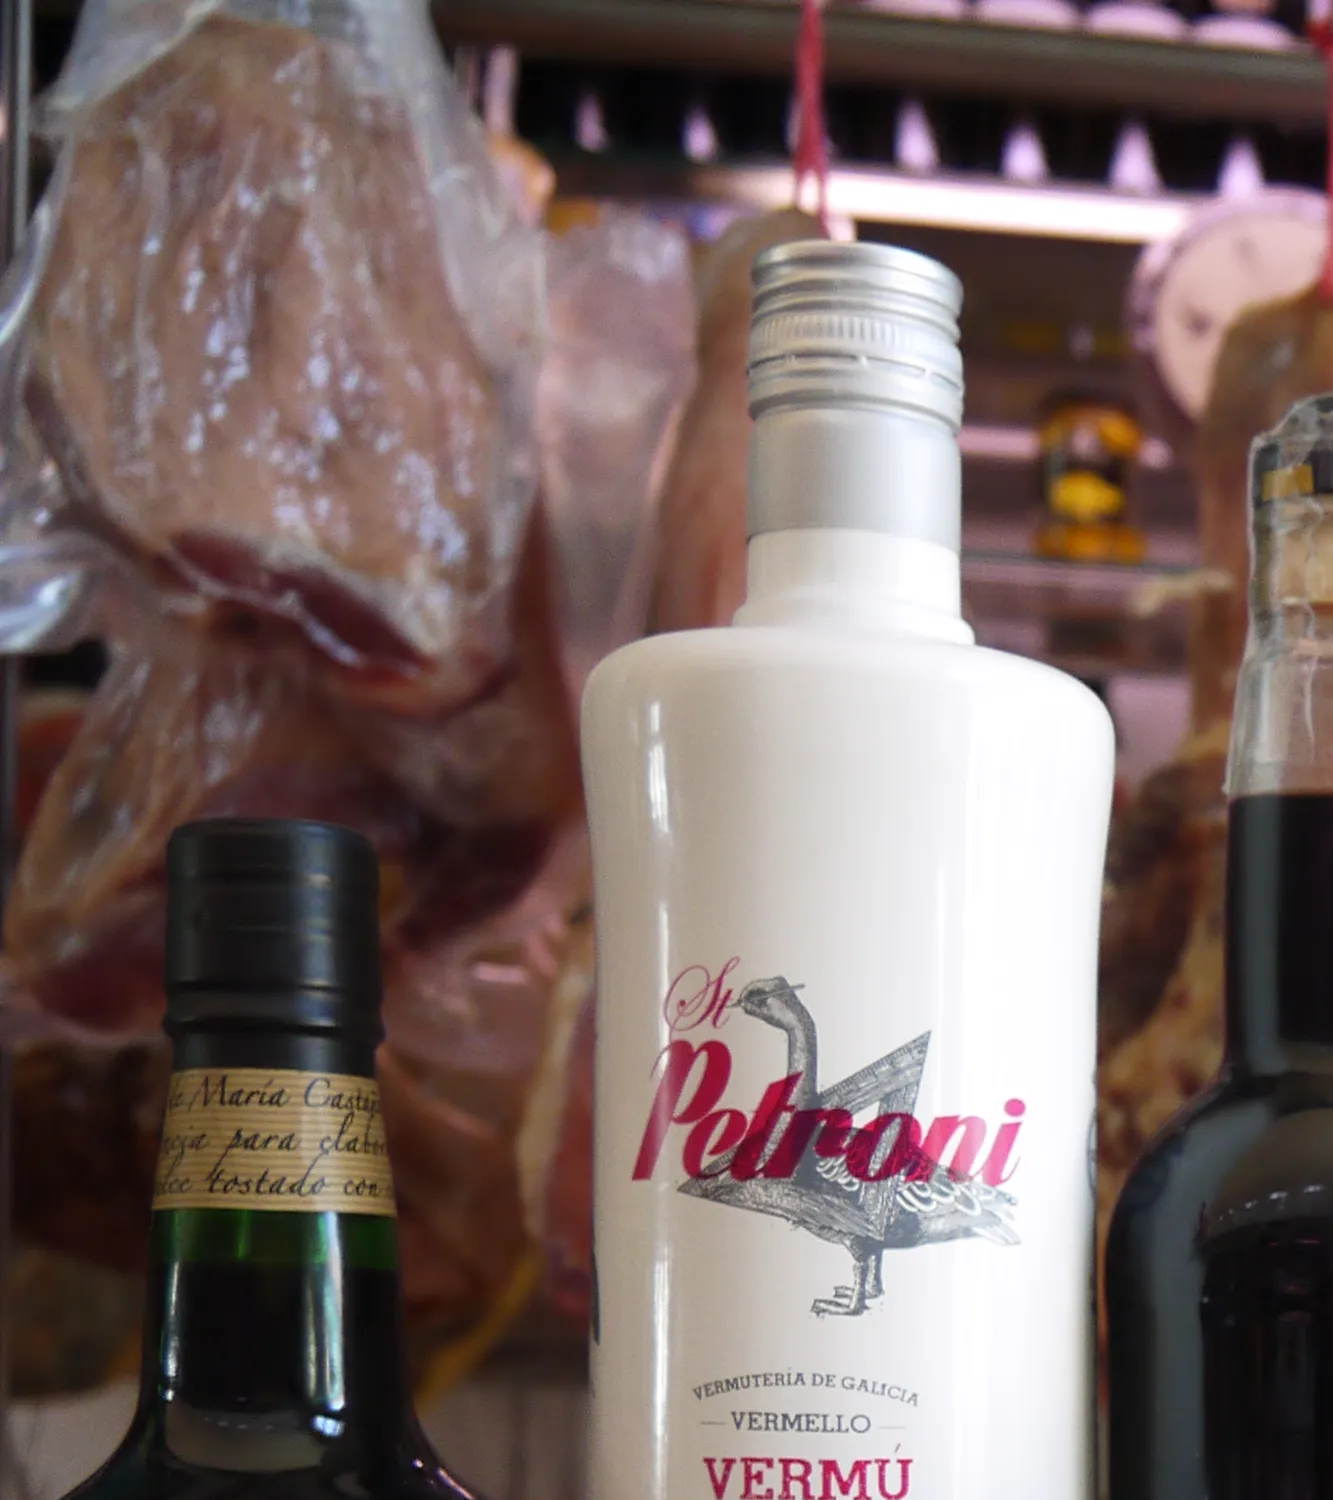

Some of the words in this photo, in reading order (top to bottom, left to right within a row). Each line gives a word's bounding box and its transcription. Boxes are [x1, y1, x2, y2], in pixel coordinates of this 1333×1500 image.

[189, 1075, 292, 1112] María
[631, 1039, 1026, 1187] Petroni
[209, 1153, 328, 1198] tostado
[692, 1367, 806, 1402] VERMUTERÍA
[811, 1373, 837, 1389] DE
[841, 1376, 919, 1407] GALICIA
[731, 1411, 871, 1433] VERMELLO
